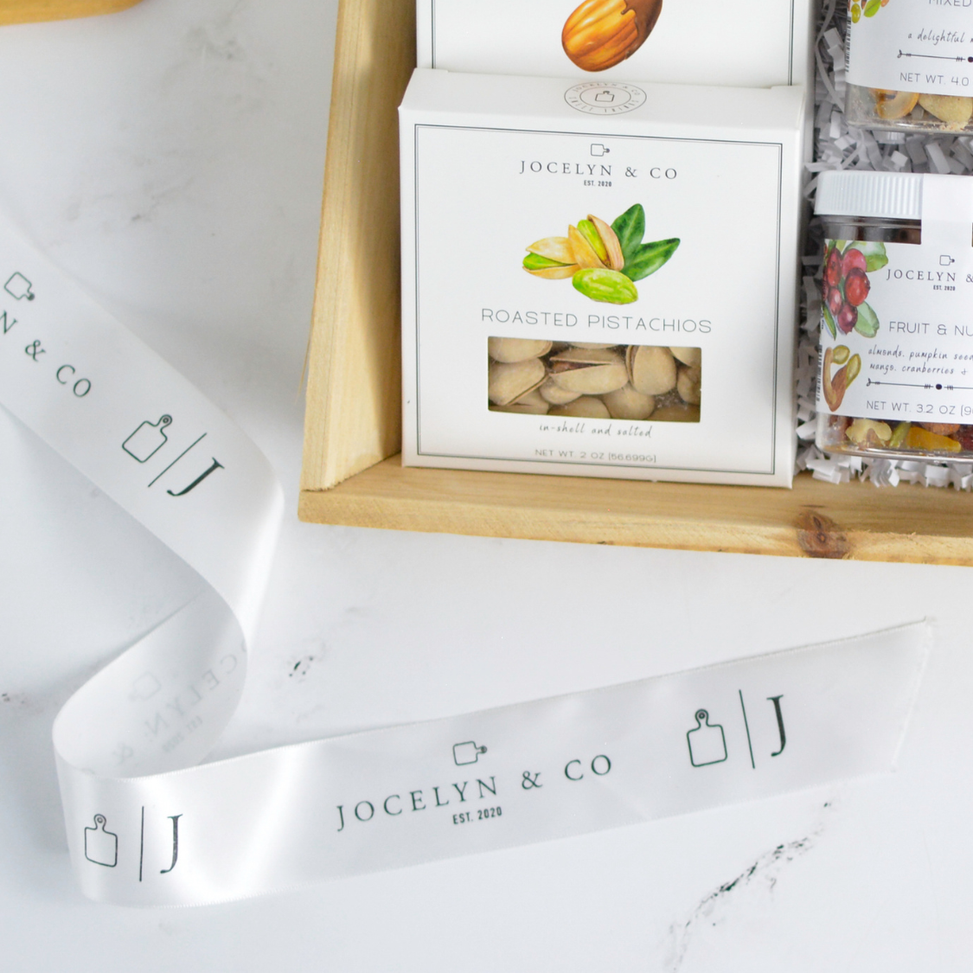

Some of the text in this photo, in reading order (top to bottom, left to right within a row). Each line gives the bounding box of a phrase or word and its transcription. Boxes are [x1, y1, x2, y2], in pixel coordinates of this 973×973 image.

[917, 28, 965, 45] delightful
[900, 72, 920, 82] NET
[925, 74, 946, 85] WT.
[951, 76, 969, 86] 4.0
[519, 161, 677, 179] JOCELYN & CO
[886, 268, 956, 282] JOCELYN
[481, 308, 712, 334] ROASTED PISTACHIOS
[889, 321, 930, 334] FRUIT
[937, 324, 947, 335] &
[909, 348, 947, 361] pumpkin
[25, 340, 91, 397] & CO
[902, 362, 954, 374] cranberries
[866, 401, 886, 410] NET
[891, 402, 912, 413] WT.
[916, 404, 933, 413] 3.2
[939, 405, 955, 415] OZ
[540, 421, 652, 438] in-shell and salted
[166, 457, 225, 496] J
[766, 695, 787, 757] J
[336, 754, 612, 832] JOCELYN & CO
[452, 806, 502, 825] EST. 2020
[160, 814, 182, 874] J
